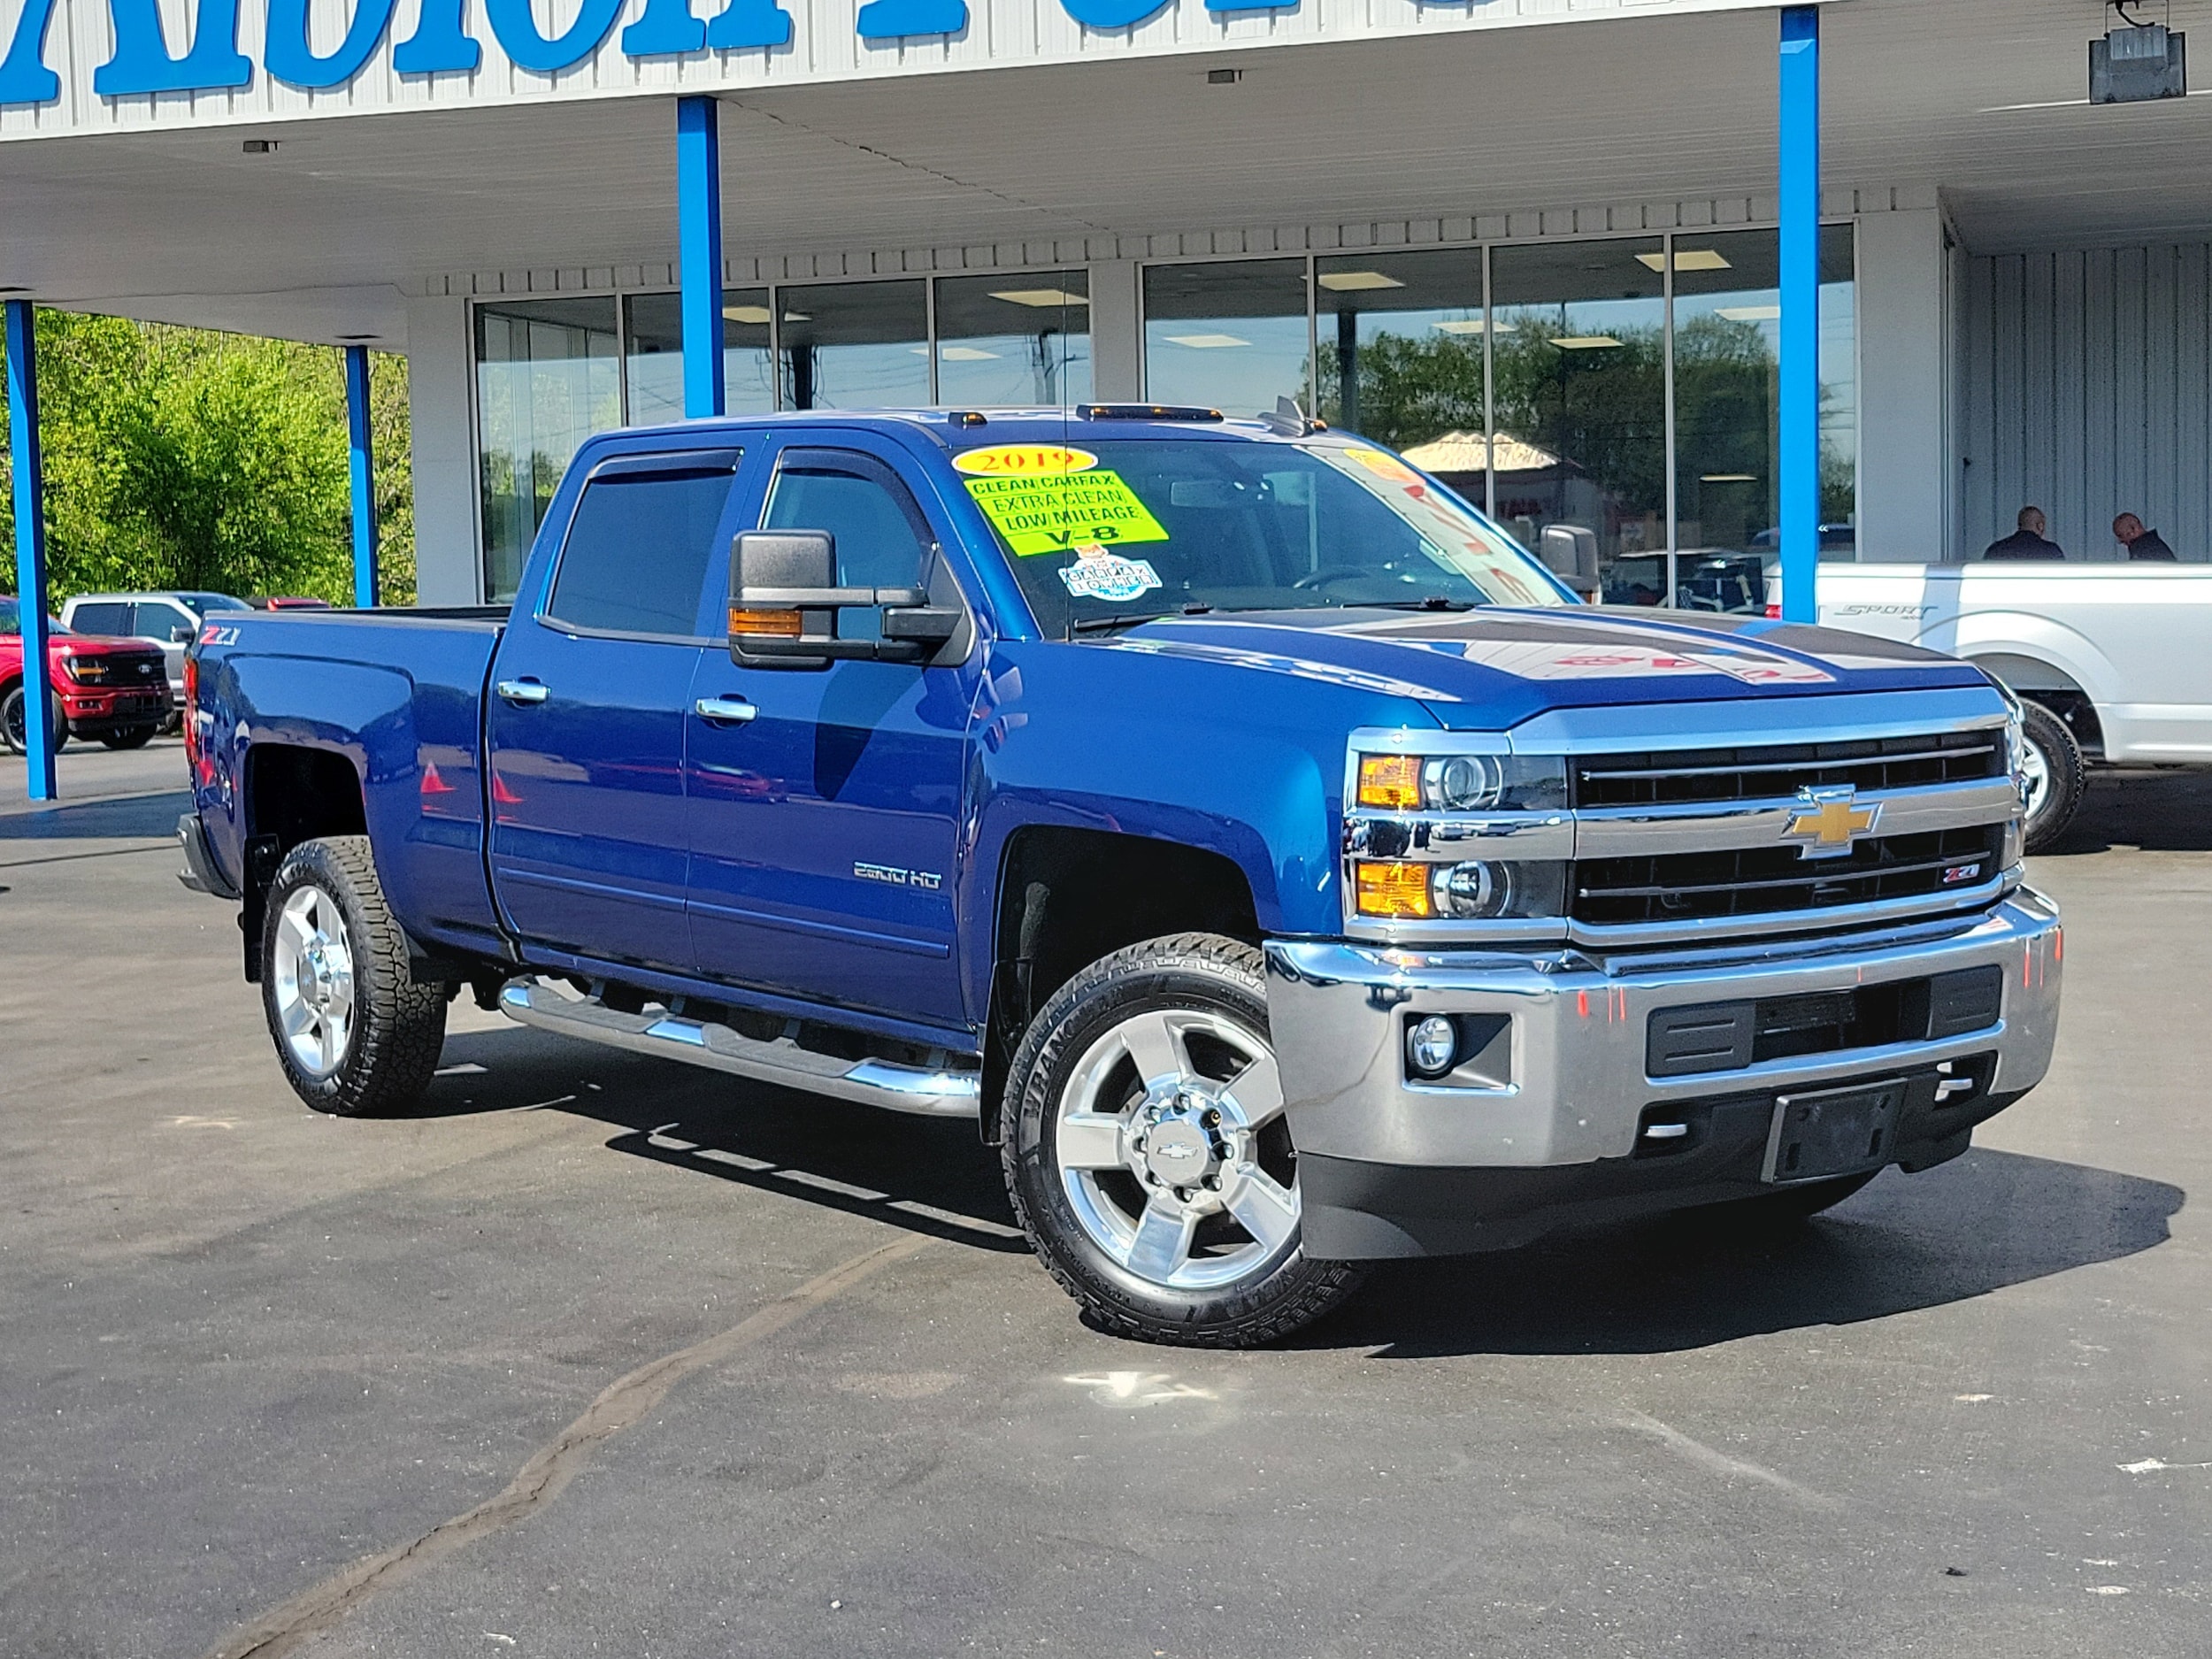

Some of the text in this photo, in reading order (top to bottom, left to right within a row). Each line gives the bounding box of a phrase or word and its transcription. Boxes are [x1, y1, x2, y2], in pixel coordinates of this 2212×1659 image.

[977, 451, 1074, 472] 2019
[973, 475, 1115, 495] CLEAN CARFAX
[993, 489, 1124, 513] EXTRA CLEAN
[1004, 506, 1138, 531] LOW MILEAGE
[1044, 526, 1119, 546] V-8
[1833, 604, 1939, 616] SPORT
[1943, 863, 1980, 884] Z71
